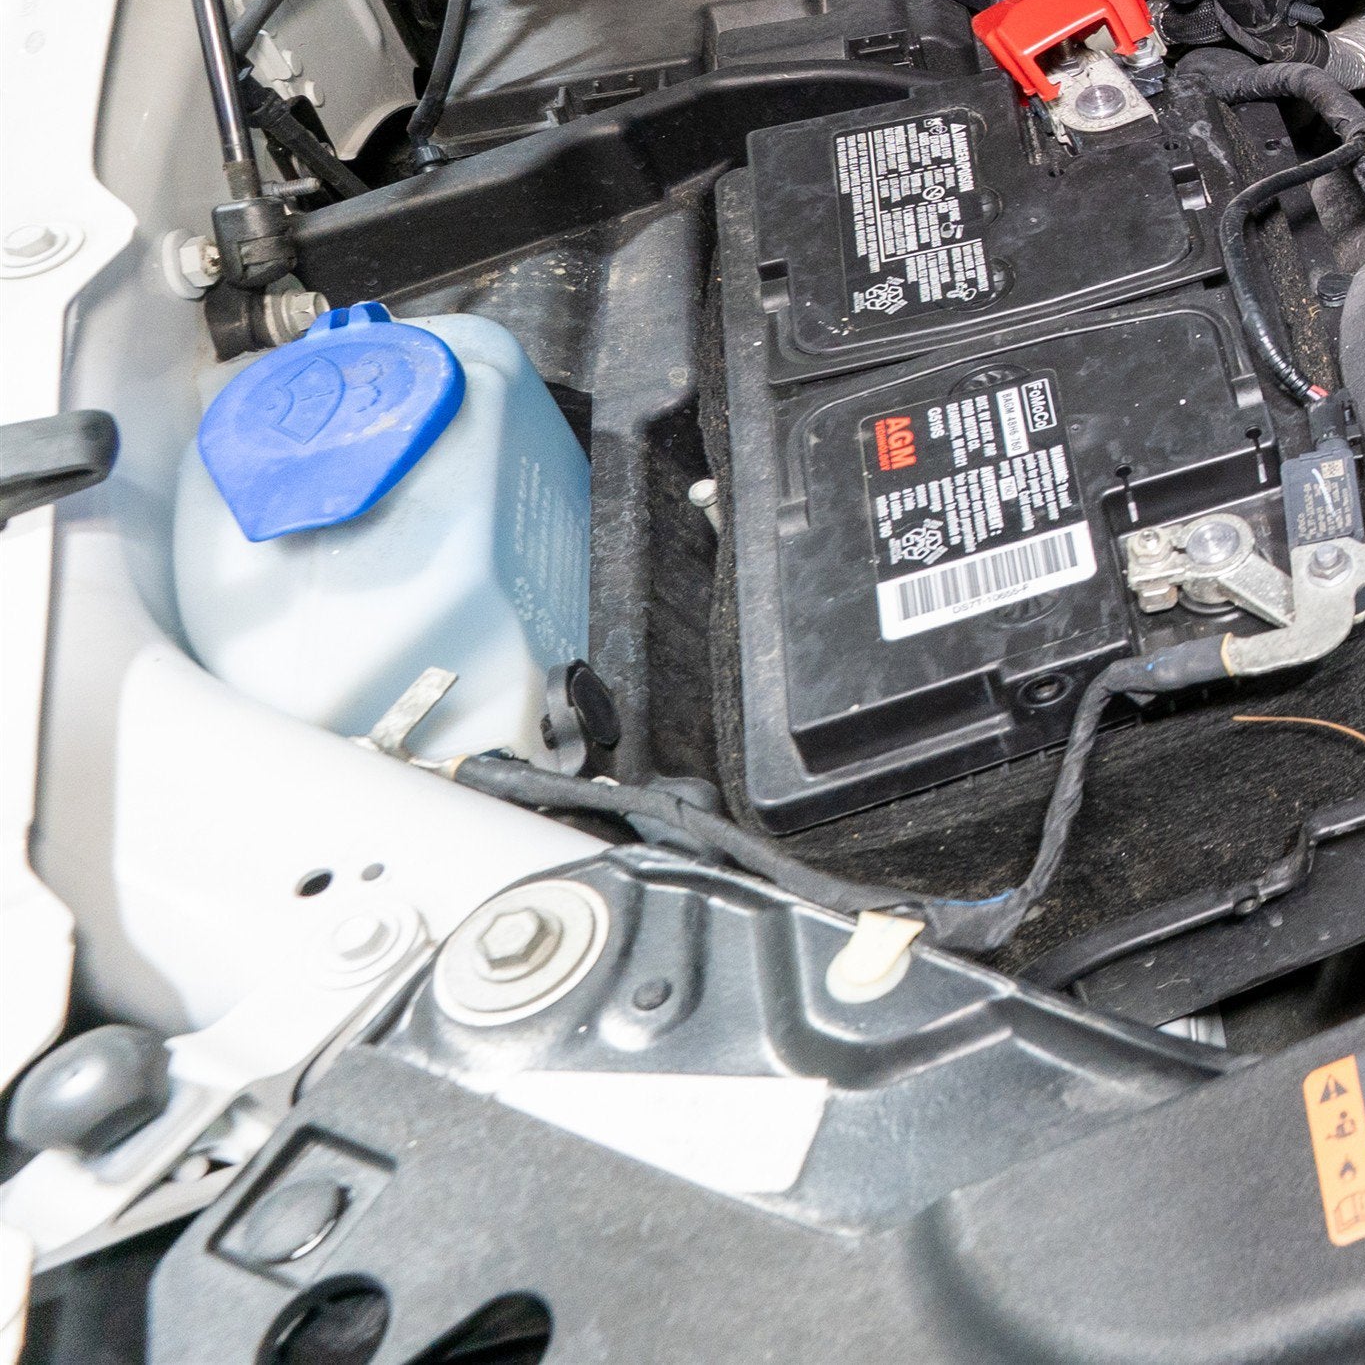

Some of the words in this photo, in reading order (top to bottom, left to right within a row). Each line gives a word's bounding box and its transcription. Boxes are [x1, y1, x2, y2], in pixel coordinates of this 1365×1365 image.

[1003, 393, 1014, 413] BAGM
[1028, 382, 1049, 428] FoMoCo
[1007, 416, 1018, 435] 48H6
[875, 421, 890, 471] TECHNOLOGY
[887, 416, 916, 469] AGM
[1011, 437, 1021, 450] 760
